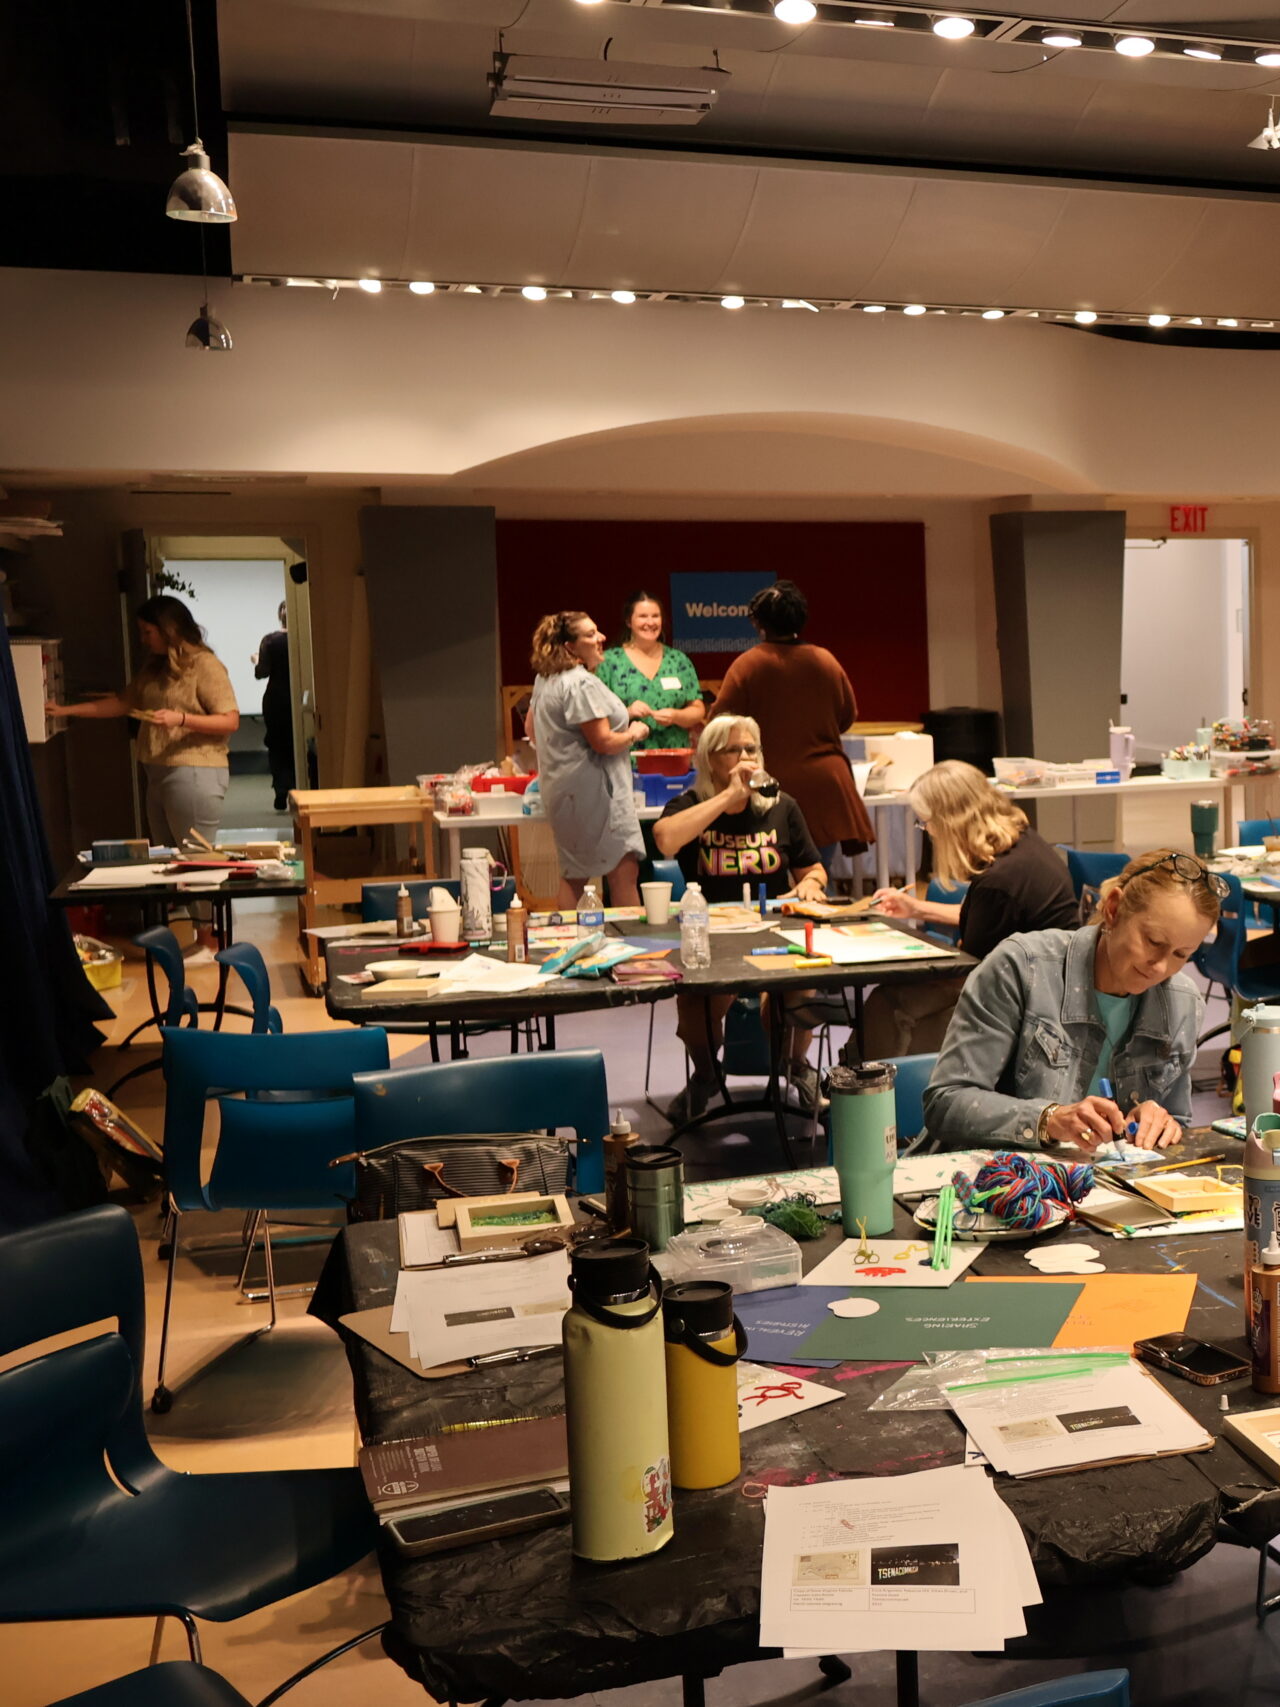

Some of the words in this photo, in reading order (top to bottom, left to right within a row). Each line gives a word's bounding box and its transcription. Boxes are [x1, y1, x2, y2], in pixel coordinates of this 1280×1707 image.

[1169, 505, 1208, 533] EXIT
[685, 602, 751, 617] Welcom
[698, 828, 778, 849] MUSEUM
[697, 846, 782, 876] NERD
[743, 1326, 806, 1337] REVEALIN
